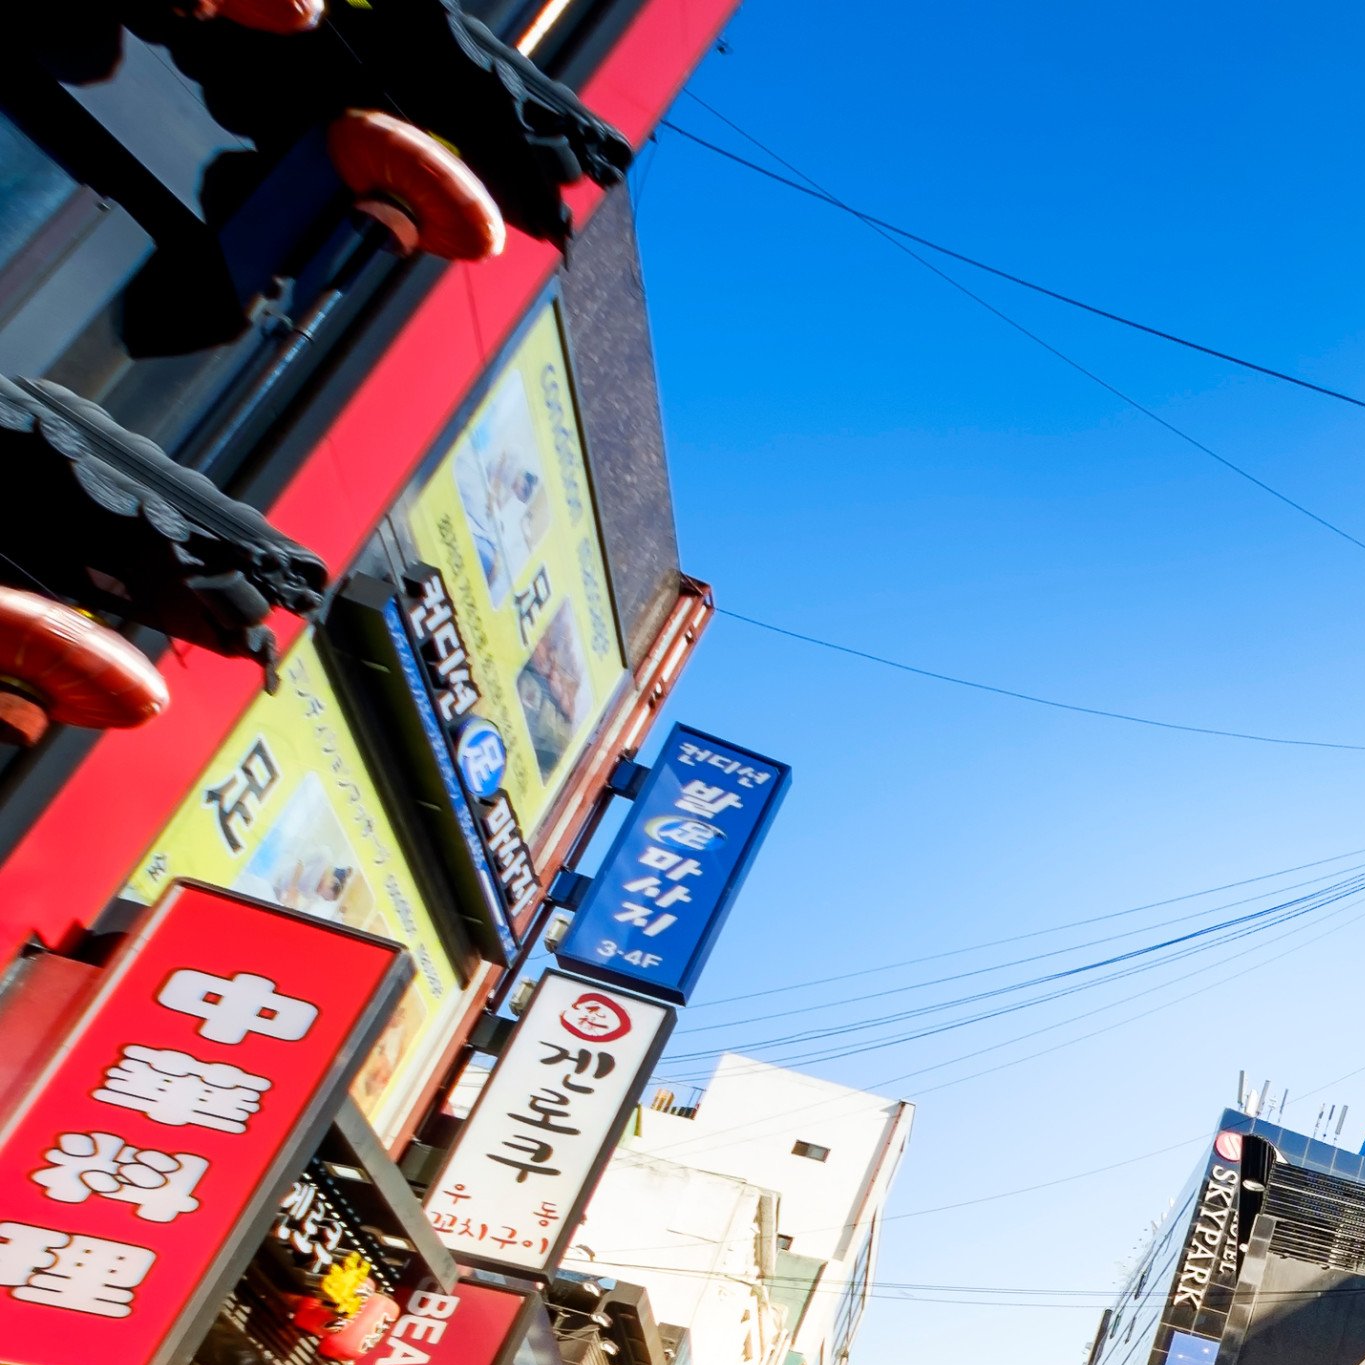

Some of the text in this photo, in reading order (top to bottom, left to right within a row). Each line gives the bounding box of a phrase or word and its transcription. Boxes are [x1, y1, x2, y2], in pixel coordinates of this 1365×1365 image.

[675, 779, 744, 820] 발
[678, 742, 773, 789] 컨디션
[614, 846, 703, 938] 마사지
[485, 1040, 616, 1184] 겐로쿠
[1172, 1164, 1240, 1312] SKYPARK
